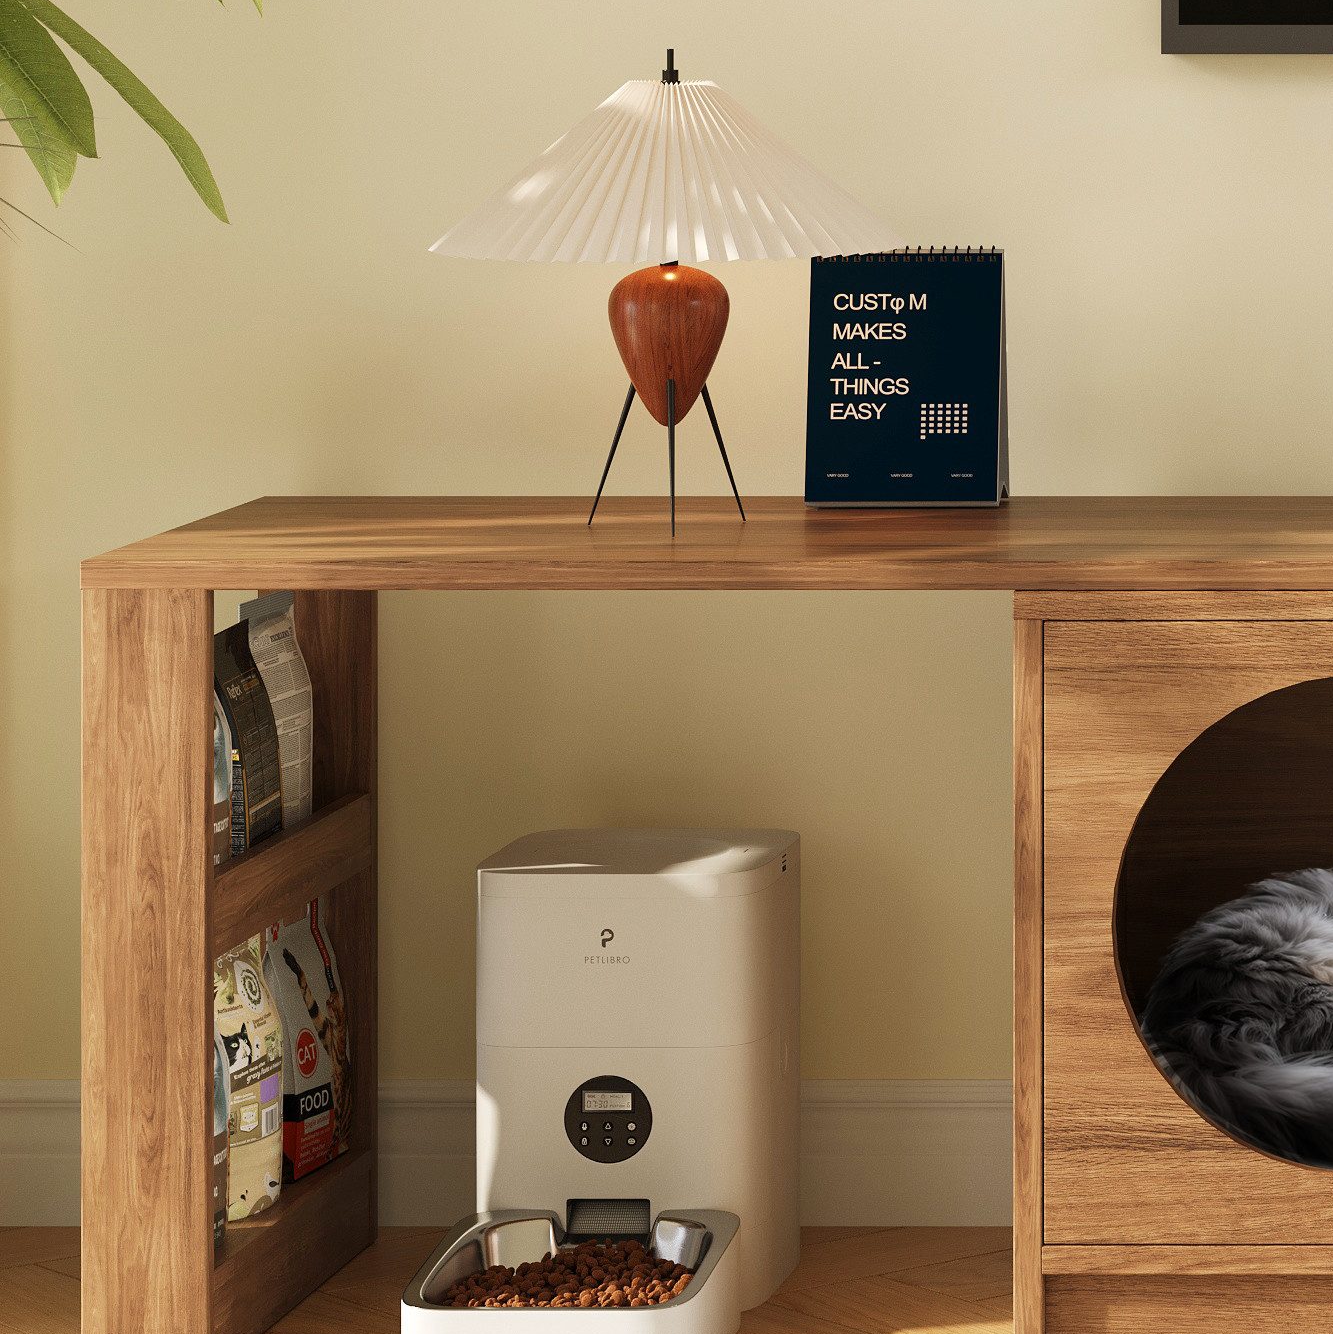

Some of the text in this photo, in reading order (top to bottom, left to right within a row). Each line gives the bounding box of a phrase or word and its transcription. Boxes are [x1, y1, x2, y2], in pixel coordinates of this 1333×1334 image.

[832, 323, 907, 340] MAKES
[830, 352, 870, 370] ALL
[829, 378, 910, 395] THINGS
[830, 403, 887, 420] EASY
[584, 956, 631, 964] PETLIBRO
[297, 1043, 317, 1065] CAT
[300, 1089, 329, 1115] FOOD
